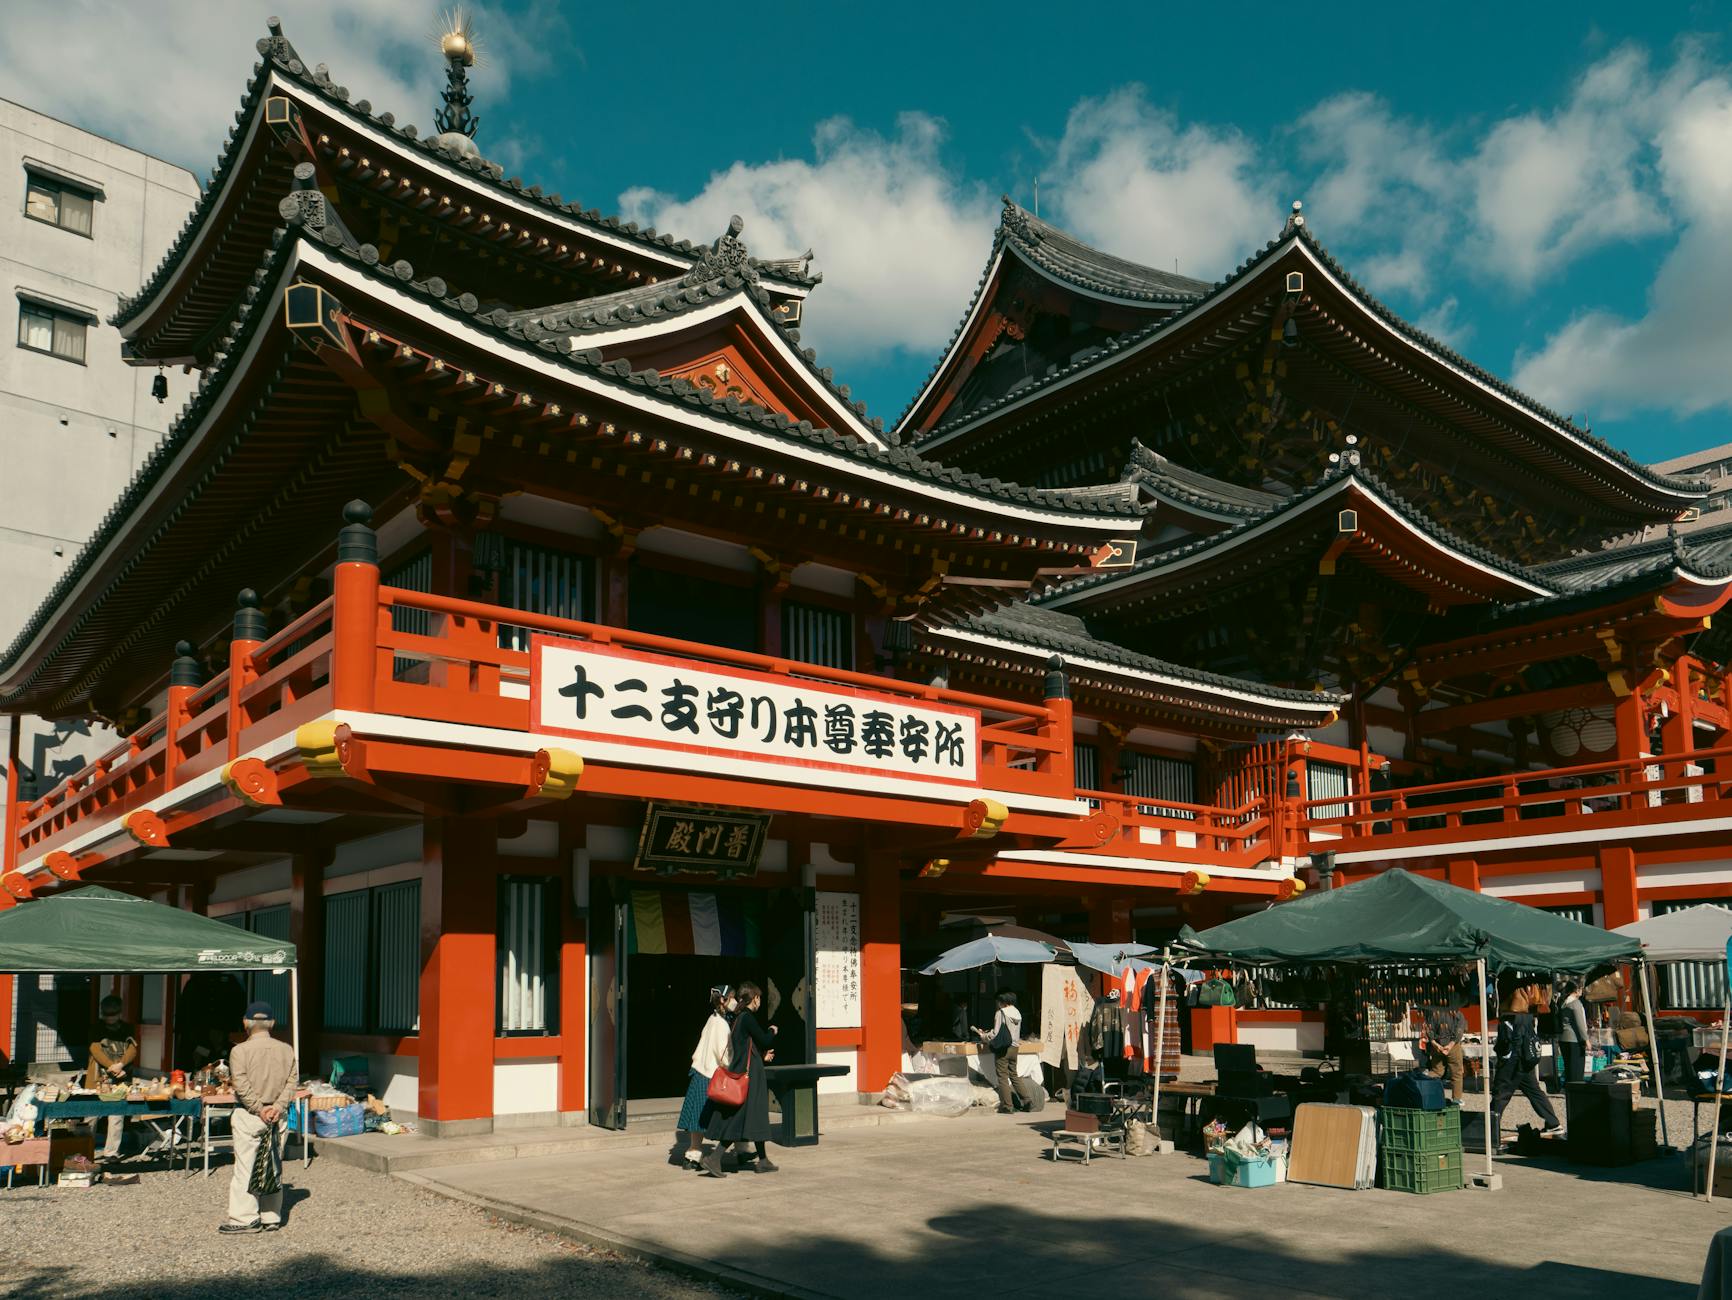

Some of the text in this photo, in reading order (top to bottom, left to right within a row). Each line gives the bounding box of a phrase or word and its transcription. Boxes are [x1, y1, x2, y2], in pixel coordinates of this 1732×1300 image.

[558, 664, 965, 768] 十二支守り本尊奉安所
